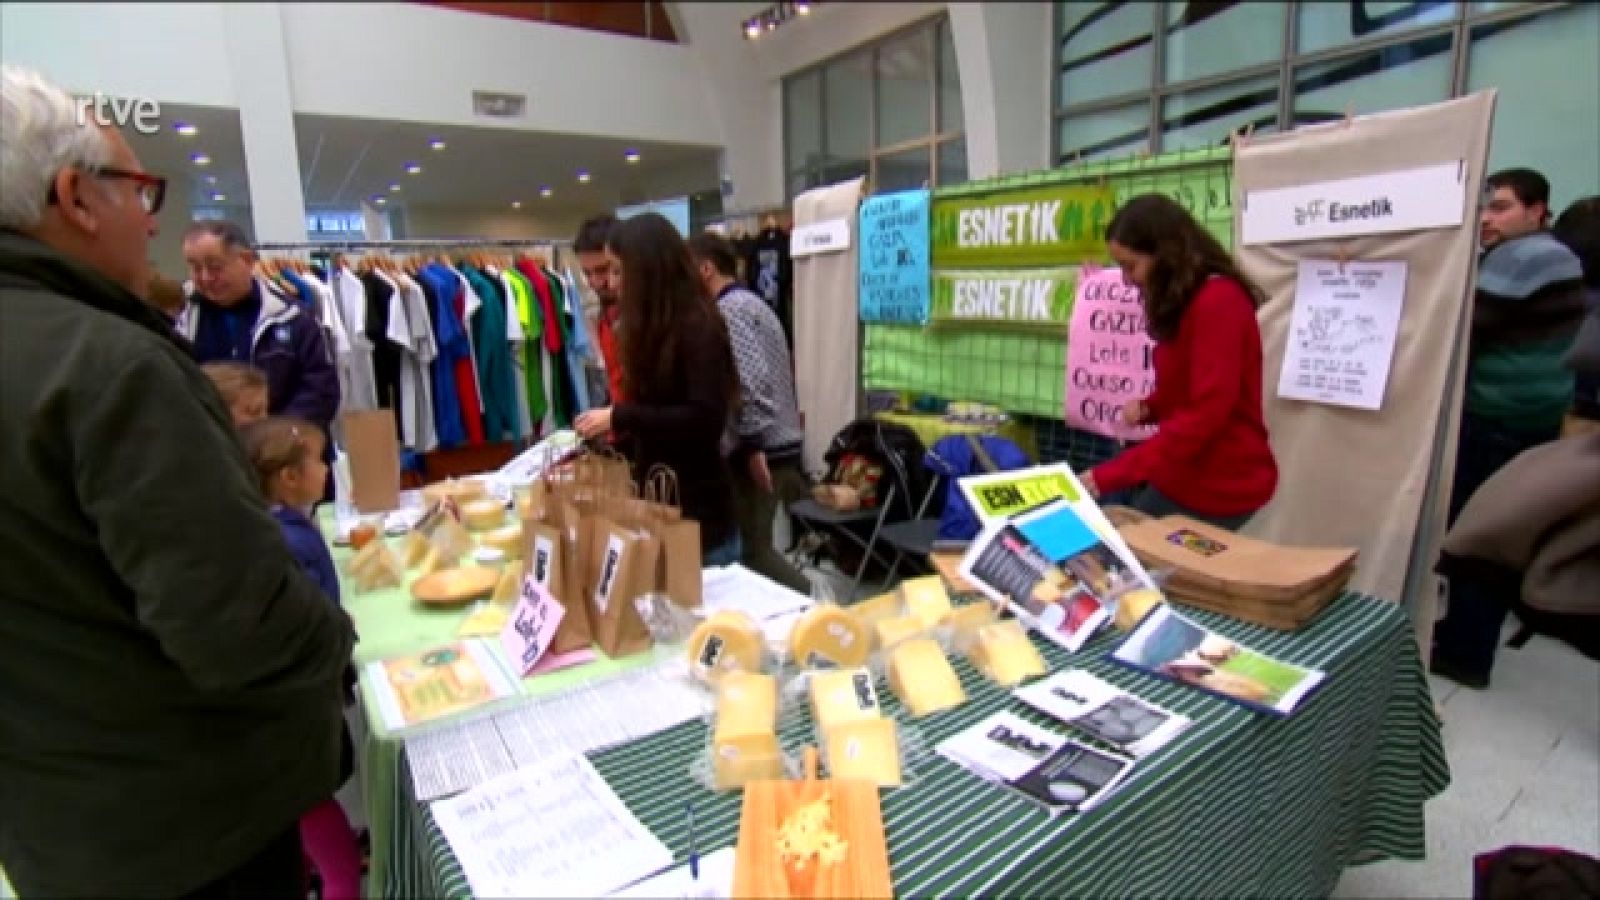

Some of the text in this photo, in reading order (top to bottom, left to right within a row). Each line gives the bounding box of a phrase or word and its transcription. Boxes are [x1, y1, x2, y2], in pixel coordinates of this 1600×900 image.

[957, 199, 1062, 249] ESNETIK
[1328, 197, 1392, 223] Esnetik
[954, 278, 1053, 321] ESNETIK
